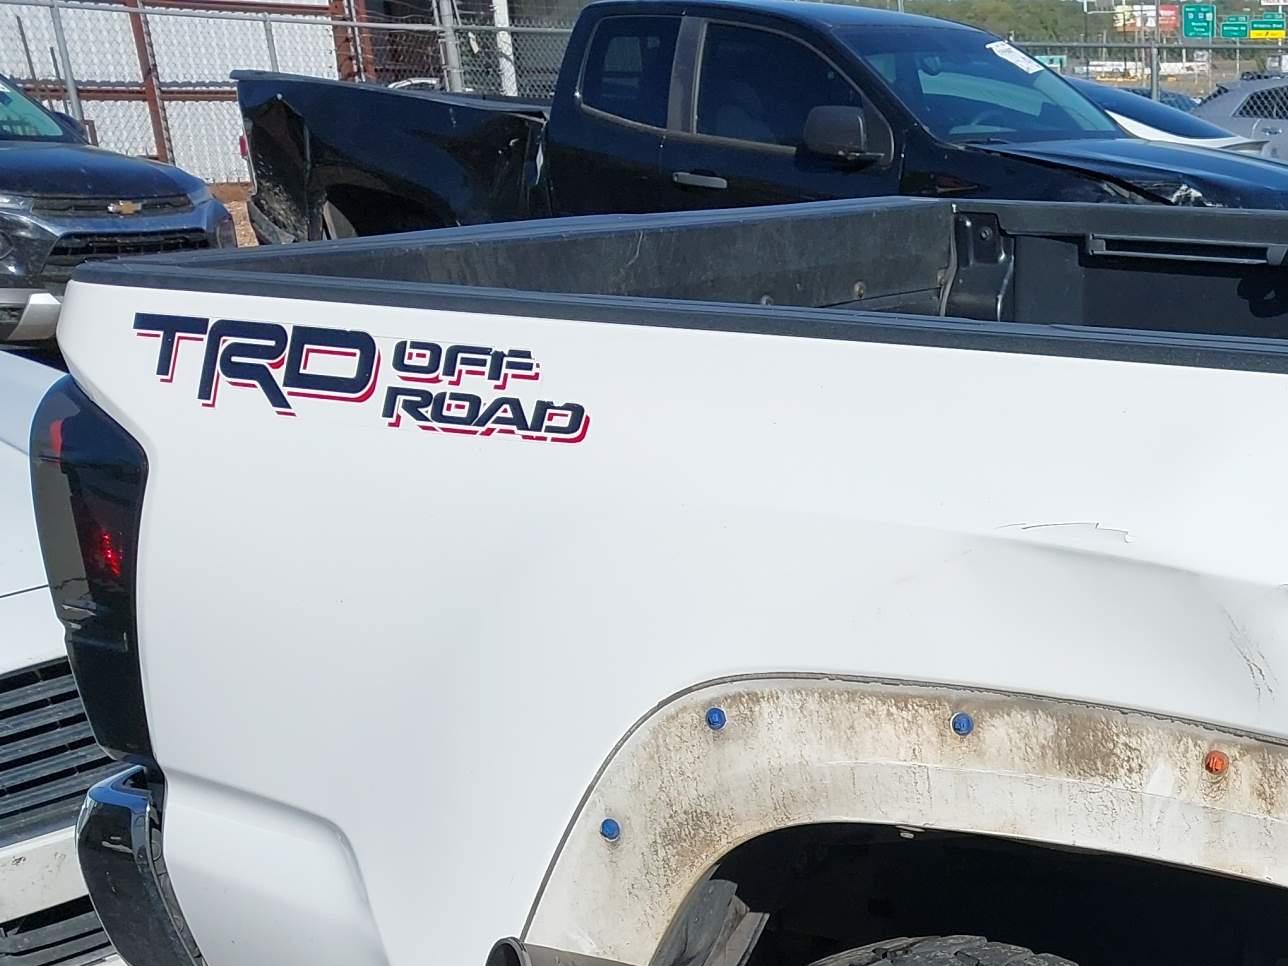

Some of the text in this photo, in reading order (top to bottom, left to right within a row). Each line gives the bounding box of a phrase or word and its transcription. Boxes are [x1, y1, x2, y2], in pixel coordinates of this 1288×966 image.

[133, 312, 381, 417] TRD
[391, 340, 540, 389] OFF
[381, 386, 591, 444] ROAD
